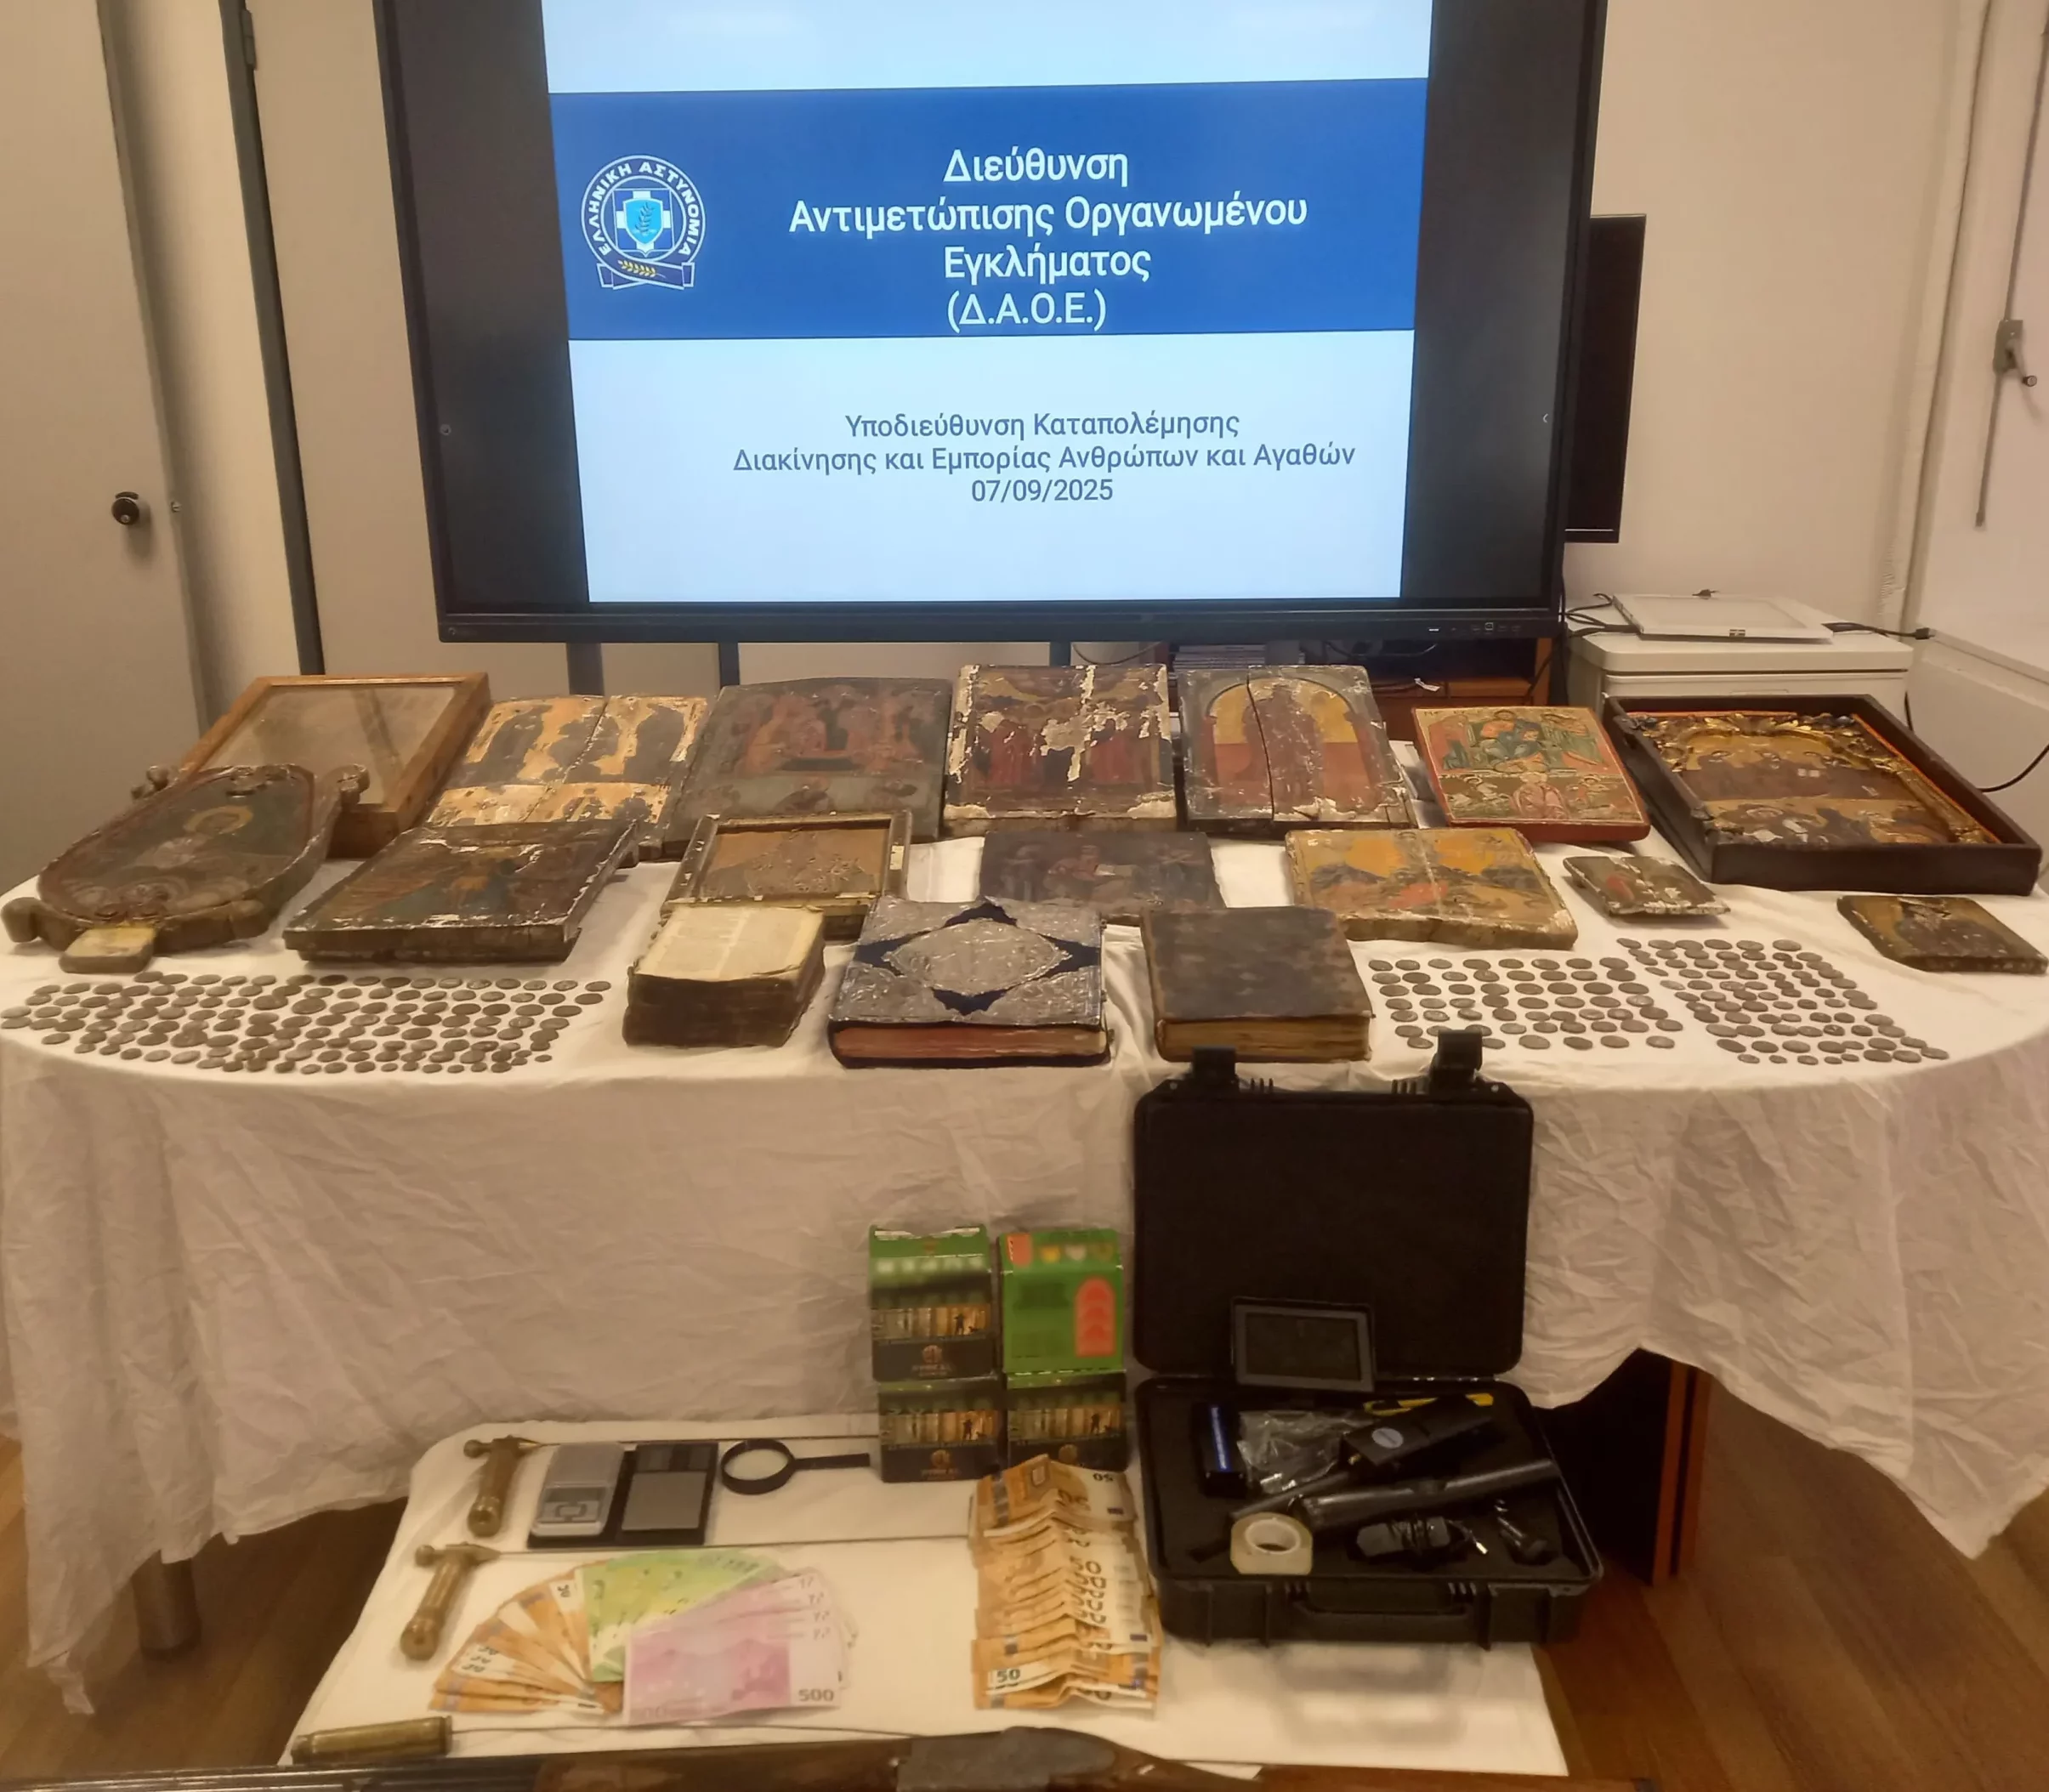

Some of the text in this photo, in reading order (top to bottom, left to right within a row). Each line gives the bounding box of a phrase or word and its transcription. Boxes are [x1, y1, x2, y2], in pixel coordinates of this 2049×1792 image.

[944, 148, 1128, 187] Διεύθυνση
[588, 162, 701, 257] ΕΛΛΗΝΙΚΗ ΑΣΤΥΝΟΜΙΑ
[789, 191, 1307, 239] Αντιμετώπισης Οργανωμένου
[945, 242, 1150, 286] Εγκλήματος
[948, 290, 1105, 333] (Δ.Α.Ο.Ε.)
[845, 410, 1240, 441] Υποδιεύθυνση Καταπολέμησης
[734, 441, 1356, 475] Διακίνησης και Εμπορίας Ανθρώπων και Αγαθών
[972, 479, 1114, 503] 07/09/2025
[996, 1669, 1020, 1682] 50
[798, 1689, 835, 1702] 500
